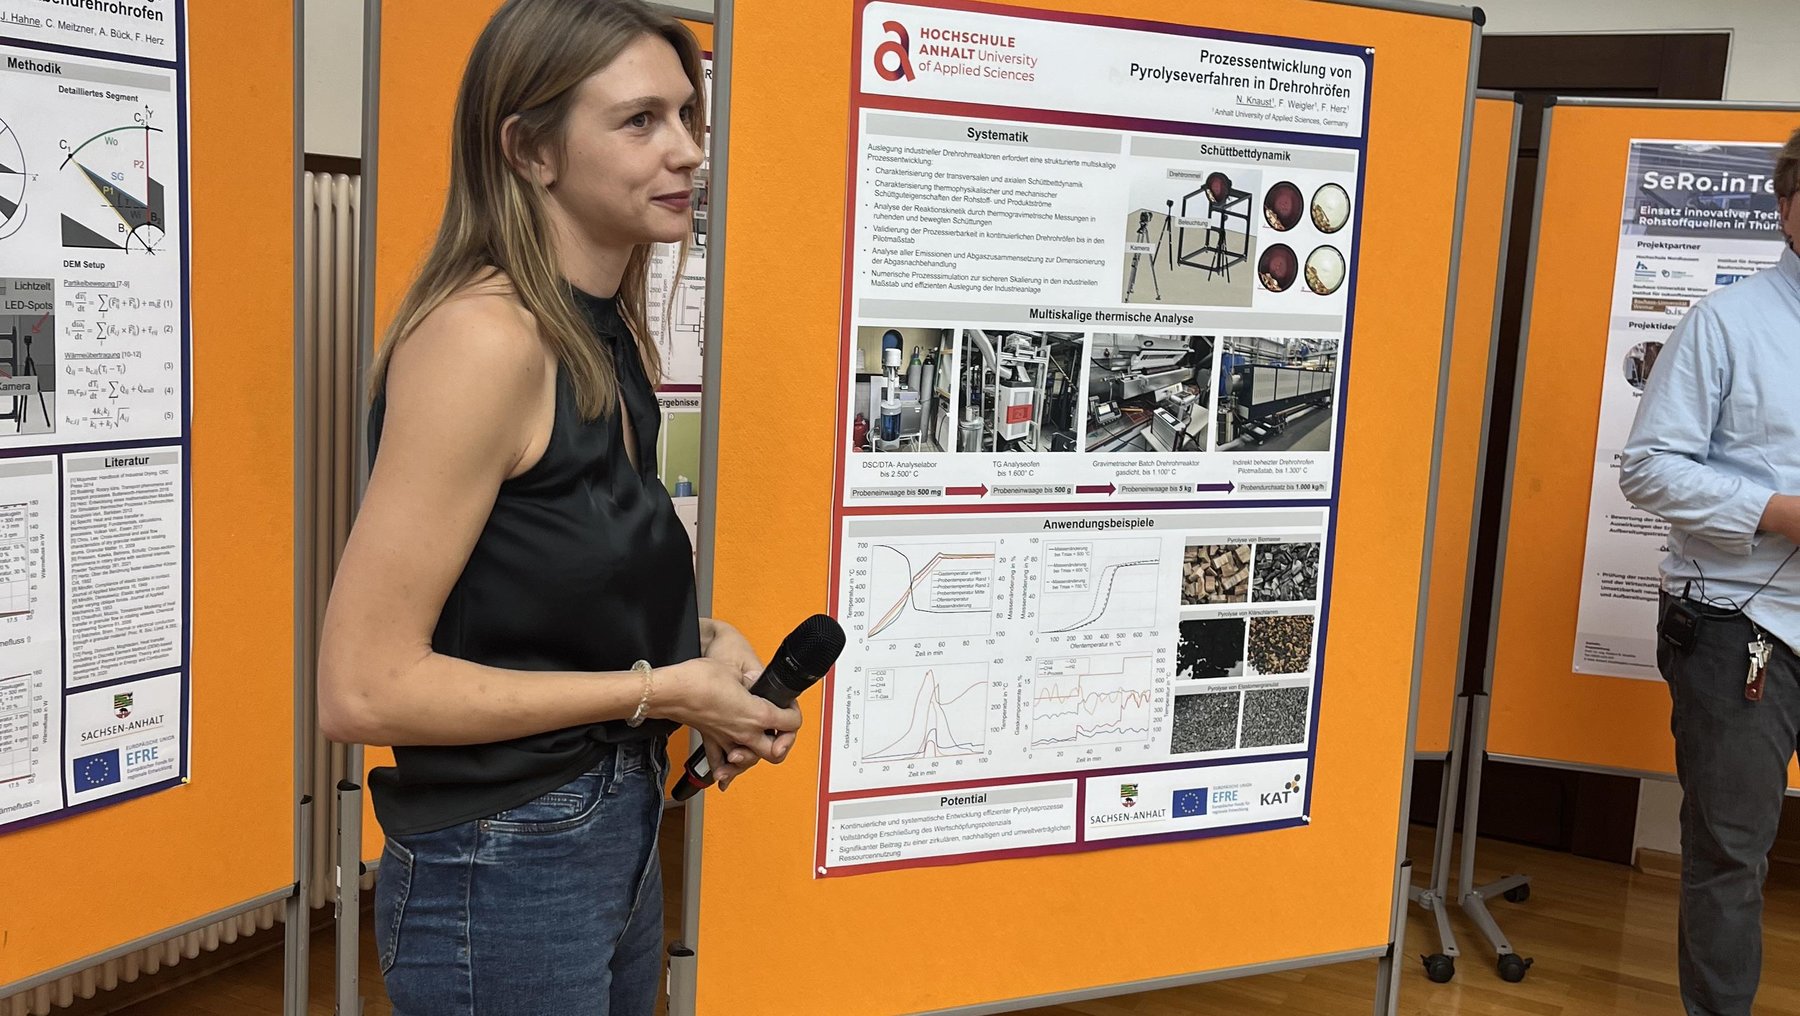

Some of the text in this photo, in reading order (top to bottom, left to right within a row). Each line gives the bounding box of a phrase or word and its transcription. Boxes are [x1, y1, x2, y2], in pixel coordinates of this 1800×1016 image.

[1, 11, 8, 21] J.
[46, 18, 56, 28] C.
[58, 21, 97, 36] Meitzner,
[100, 28, 109, 36] A.
[111, 29, 134, 41] Bück,
[136, 33, 144, 41] F.
[146, 35, 164, 45] Herz
[920, 28, 1016, 48] HOCHSCHULE
[919, 44, 1038, 69] ANHALT University
[8, 57, 62, 74] Methodik
[919, 60, 1035, 82] of Applied Sciences
[1200, 50, 1352, 79] Prozessentwicklung von
[1130, 63, 1350, 98] Pyrolyseverfahren in Drehrohröfen
[59, 85, 139, 102] Detailliertes Segment
[967, 127, 1029, 142] Systematik
[868, 144, 902, 155] Auslegung
[904, 147, 940, 157] industrieller
[943, 149, 1000, 160] Drehrohrreaktoren
[1002, 154, 1028, 162] erfordert
[1045, 158, 1079, 166] strukturierte
[1081, 161, 1116, 170] multiskalige
[1200, 144, 1291, 161] Schüttbettdynamik
[133, 160, 144, 169] P2
[111, 172, 124, 181] SG
[875, 167, 933, 179] Charakterisierung
[947, 173, 989, 181] transversalen
[1028, 178, 1083, 188] Schüttbettdynamik
[103, 186, 113, 195] P1
[875, 180, 932, 192] Charakterisierung
[934, 184, 1000, 194] thermophysikalischer
[875, 189, 950, 201] Schüttguteigenschaften
[964, 195, 992, 203] Rohstoff-
[1008, 198, 1052, 207] Produktströme
[874, 202, 899, 211] Analyse
[914, 205, 966, 214] Reaktionskinetik
[987, 210, 1053, 220] thermogravimetrische
[1055, 214, 1088, 223] Messungen
[1640, 205, 1681, 217] Einsatz
[1684, 208, 1751, 219] innovativer
[920, 215, 951, 224] bewegten
[953, 217, 992, 227] Schüttungen
[1639, 217, 1730, 229] Rohstoffquellen
[1734, 219, 1745, 229] in
[873, 225, 909, 237] Validierung
[923, 228, 977, 237] Prozessierbarkeit
[987, 232, 1034, 240] kontinuierlichen
[1036, 234, 1075, 242] Drehrohröfen
[873, 235, 915, 244] Pilotmaßstab
[1637, 241, 1701, 250] Projektpartner
[63, 260, 105, 269] DEM Setup
[871, 270, 910, 278] Numerische
[912, 272, 969, 280] Prozesssimulation
[1010, 276, 1041, 285] Skalierung
[948, 283, 981, 292] Auslegung
[995, 284, 1041, 294] Industrieanlage
[5, 300, 53, 312] LED-Spots
[1029, 308, 1194, 325] Multiskalige thermische Analyse
[658, 398, 699, 408] Ergebnisse
[105, 456, 150, 468] Literatur
[853, 489, 905, 497] Probeneinwaage
[1044, 518, 1154, 530] Anwendungsbeispiele
[81, 715, 164, 742] SACHSEN-ANHALT
[127, 747, 158, 766] EFRE
[940, 793, 987, 806] Potential
[1213, 791, 1238, 802] EFRE
[1260, 791, 1291, 805] KAT
[840, 820, 886, 830] Kontinuierliche
[902, 815, 944, 825] systematische
[946, 812, 981, 820] Entwicklung
[1013, 804, 1064, 814] Pyrolyseprozesse
[1091, 809, 1166, 824] SACHSEN-ANHALT
[840, 833, 878, 841] Vollständige
[880, 829, 920, 837] Erschließung
[934, 819, 1011, 832] Wertschöpfungspotenzials
[839, 844, 878, 854] Signifikanter
[962, 832, 1000, 840] nachhaltigen
[1014, 825, 1071, 835] umweltverträglichen
[839, 851, 901, 861] Ressourcennutzung
